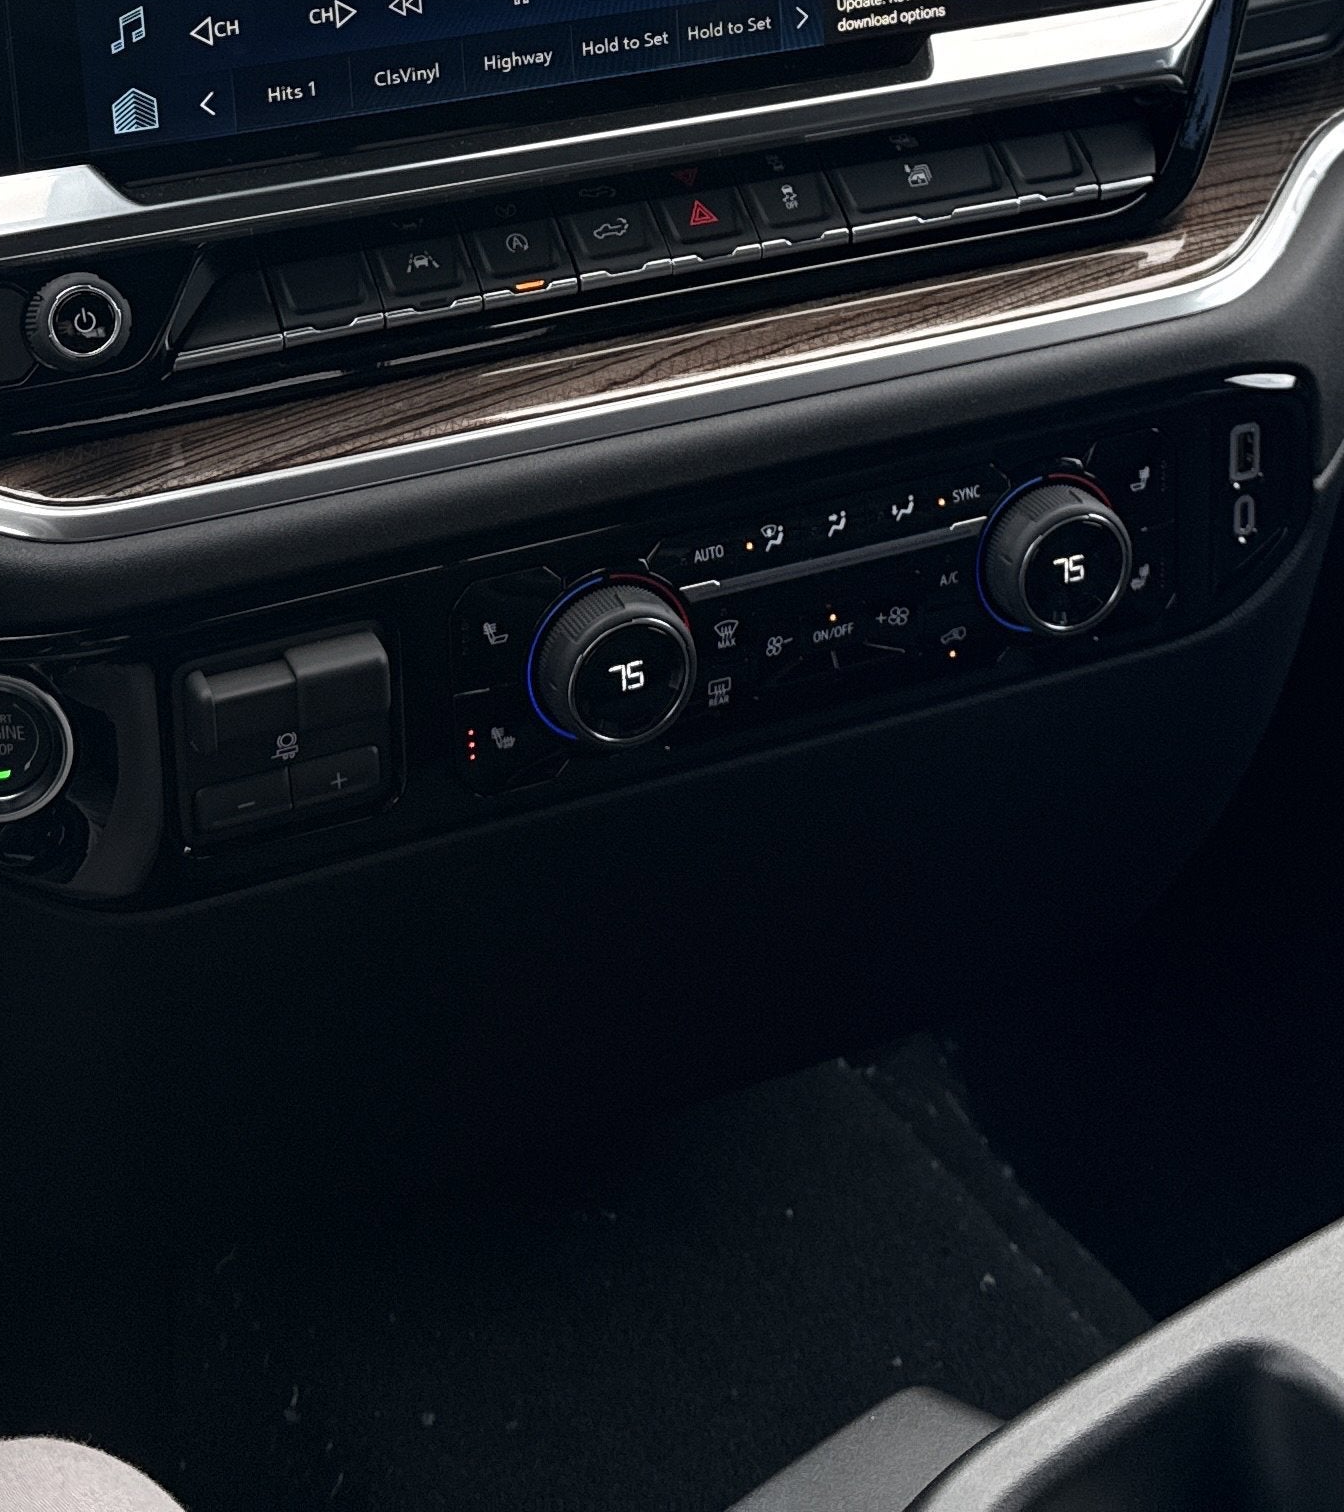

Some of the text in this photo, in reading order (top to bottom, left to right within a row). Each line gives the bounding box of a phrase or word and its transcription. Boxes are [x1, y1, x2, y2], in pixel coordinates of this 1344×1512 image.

[309, 7, 334, 24] CH
[837, 4, 946, 32] download options
[214, 19, 240, 37] CH
[687, 15, 772, 41] Hold to Set
[582, 31, 669, 57] Hold to Set
[483, 49, 553, 72] Highway
[374, 62, 440, 87] ClsVinyl
[268, 80, 316, 103] Hits 1
[952, 485, 981, 503] SYNC
[694, 545, 724, 564] AUTO
[939, 571, 959, 587] A/C
[1052, 554, 1085, 584] 75
[718, 637, 736, 649] MAX
[813, 622, 854, 643] ON/OFF
[608, 659, 645, 692] 75
[709, 694, 729, 706] REAR
